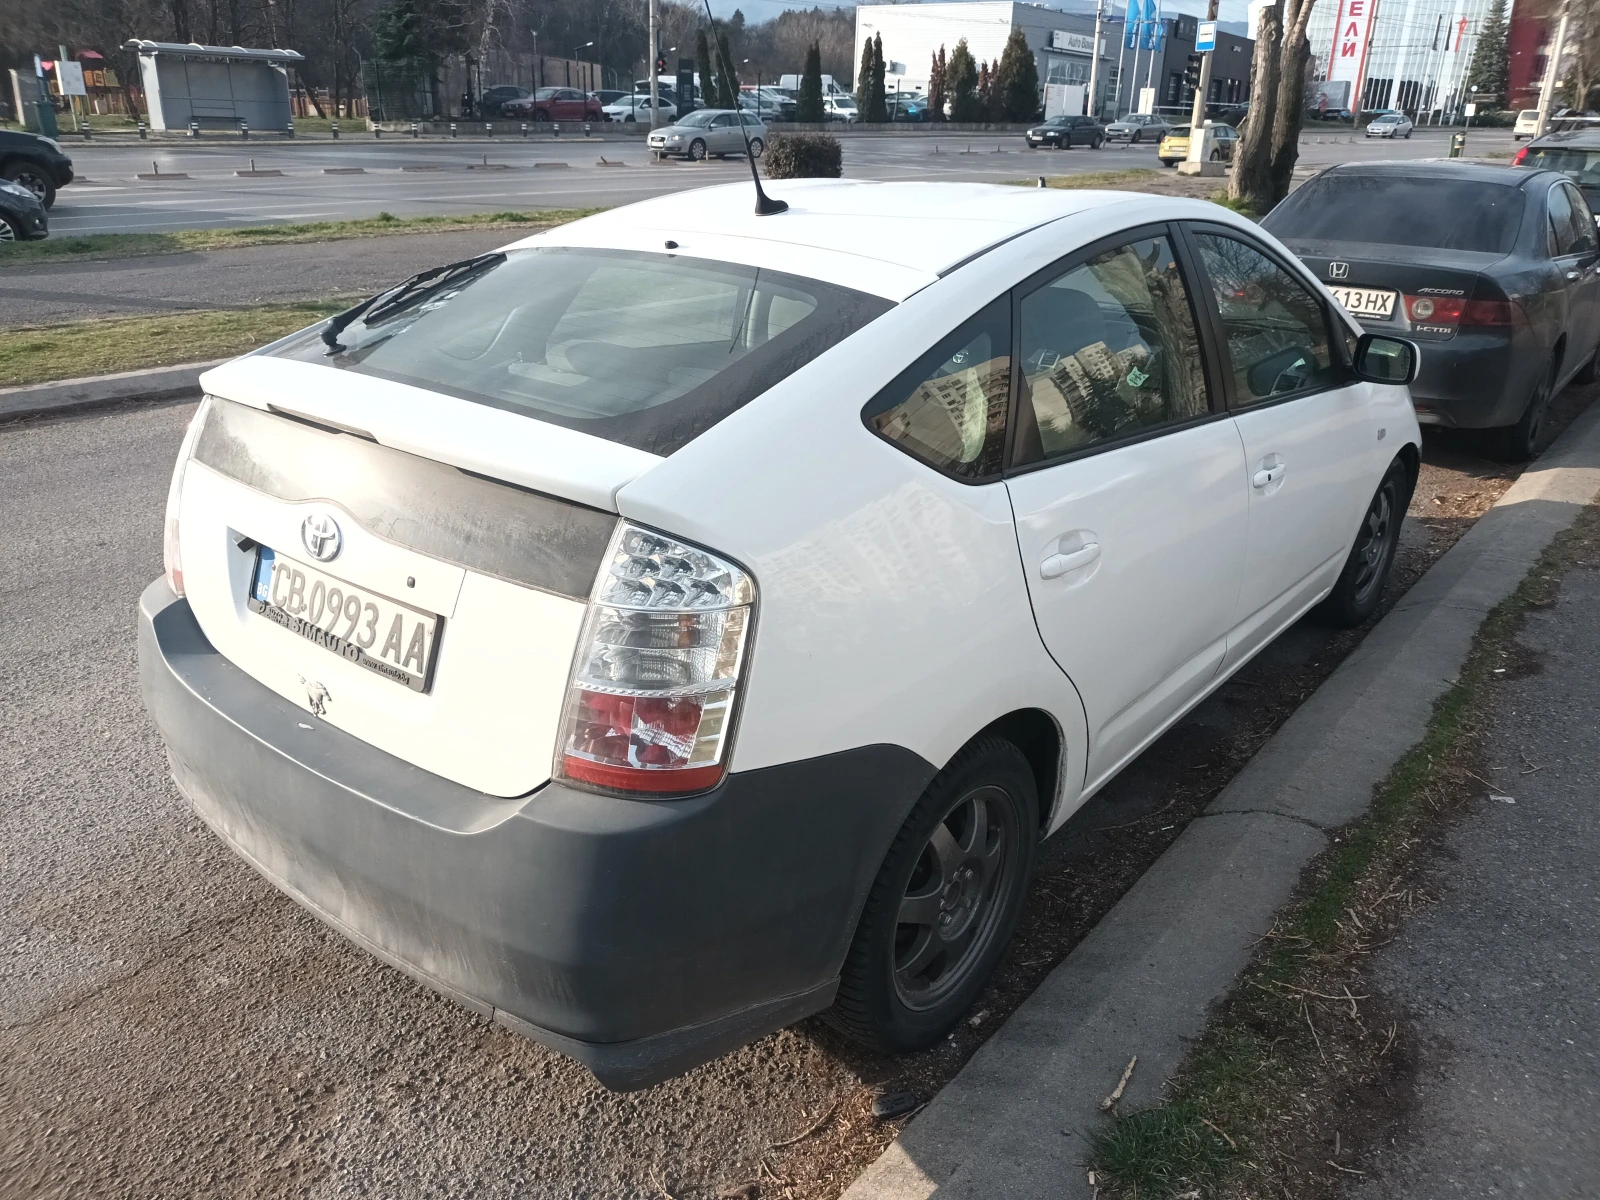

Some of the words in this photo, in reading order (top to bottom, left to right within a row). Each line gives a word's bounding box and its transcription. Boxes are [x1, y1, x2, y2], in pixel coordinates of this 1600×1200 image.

[1067, 34, 1081, 49] Auto
[1417, 287, 1465, 296] ACCORD
[1364, 292, 1391, 312] HX
[256, 582, 269, 597] BG
[273, 563, 305, 615] CB
[308, 580, 380, 650] 0993
[380, 613, 426, 675] AA
[292, 616, 362, 662] SIMAUTO
